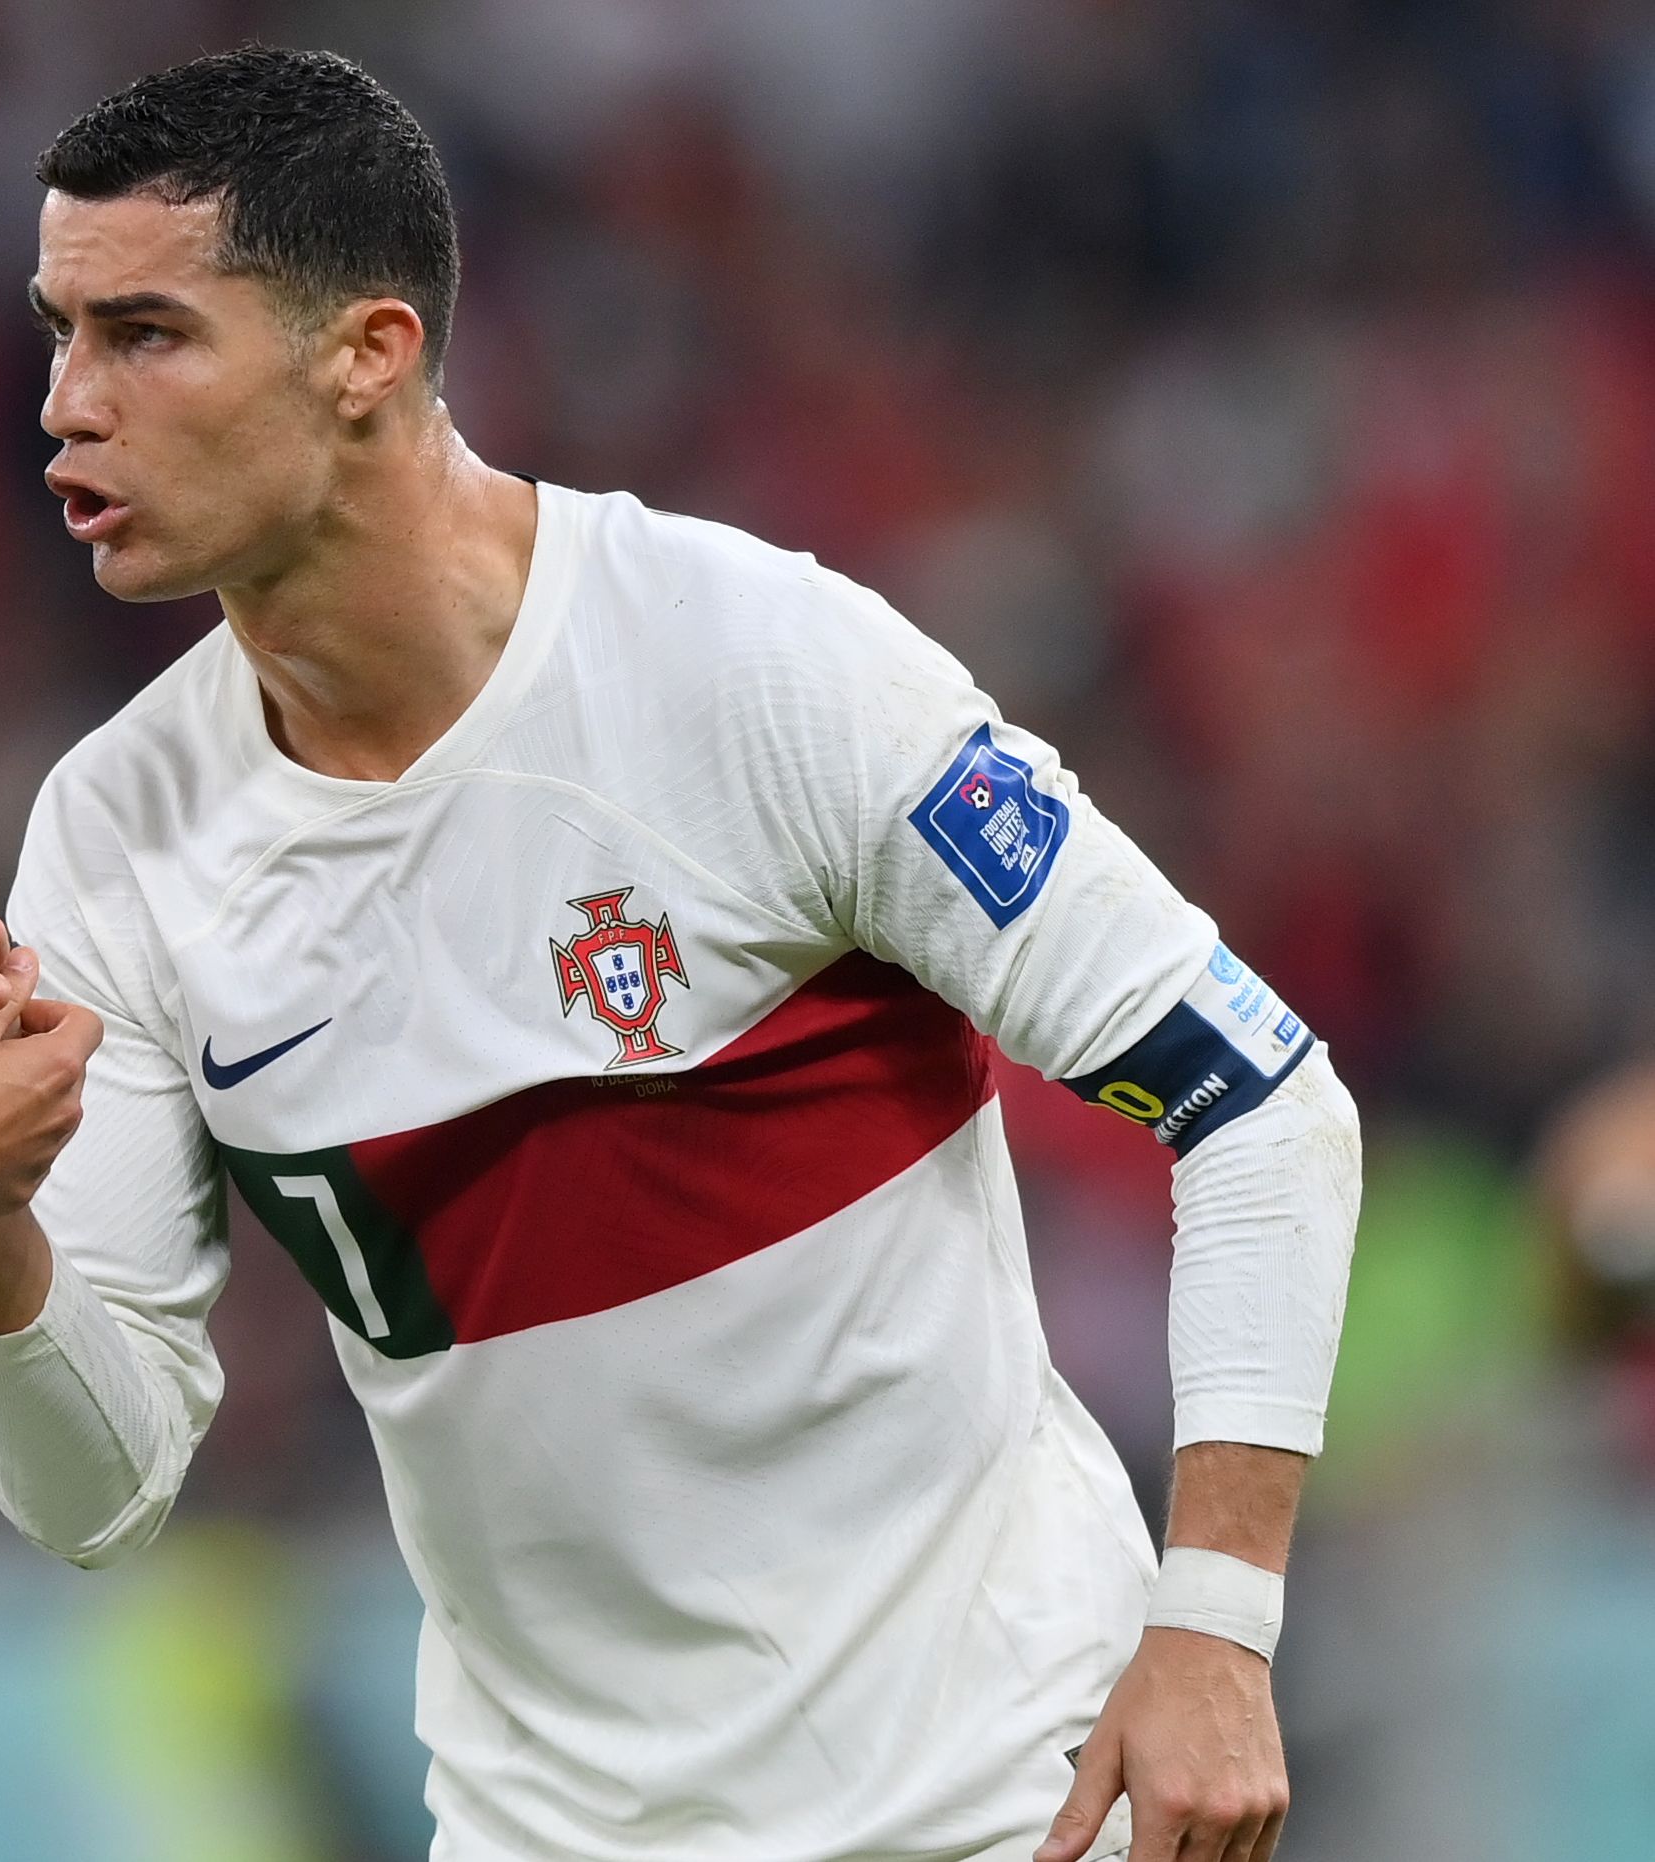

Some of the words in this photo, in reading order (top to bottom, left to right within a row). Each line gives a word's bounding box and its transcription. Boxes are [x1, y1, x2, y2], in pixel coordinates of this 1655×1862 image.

[979, 796, 1019, 842] FOOTBALL
[635, 1080, 678, 1098] DOHA
[271, 1174, 391, 1339] 7
